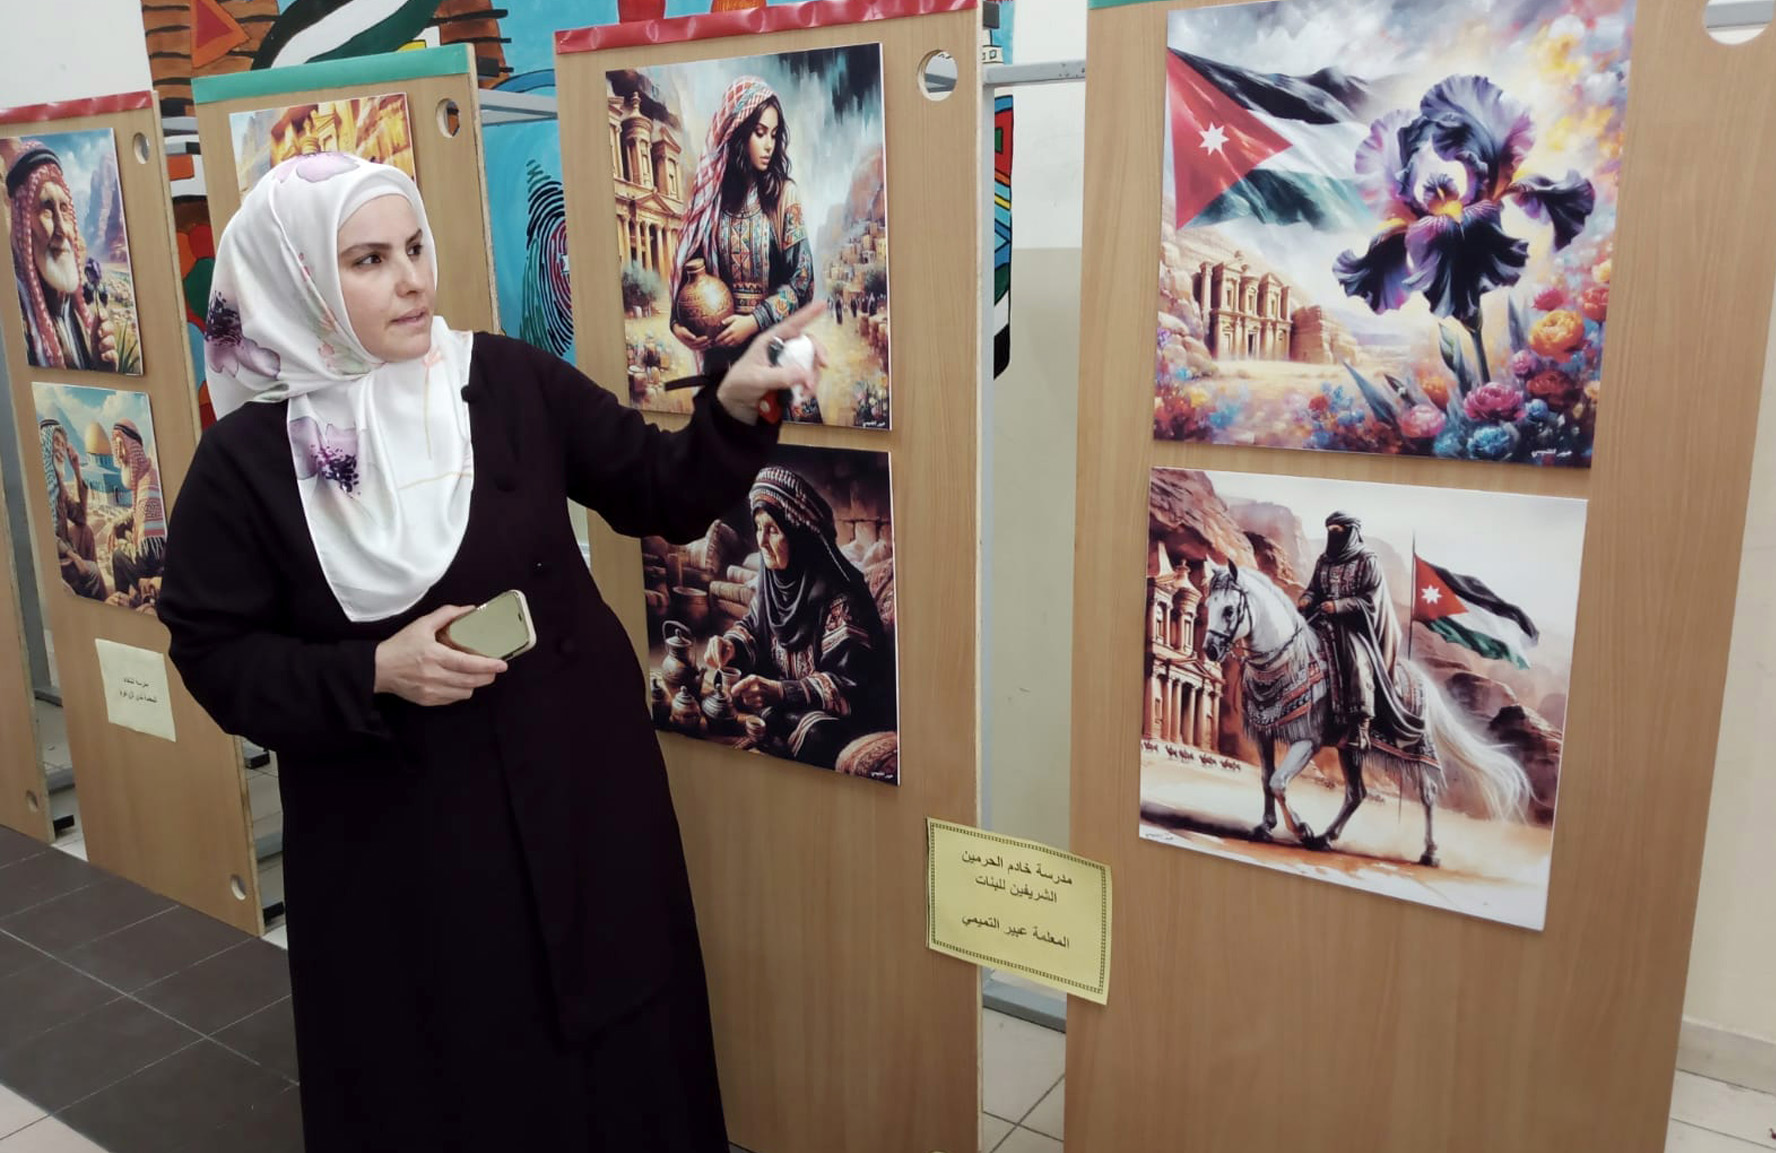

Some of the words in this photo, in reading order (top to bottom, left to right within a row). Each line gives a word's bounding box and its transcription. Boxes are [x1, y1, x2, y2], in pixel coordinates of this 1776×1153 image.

[961, 851, 1003, 868] الحرمين
[1007, 861, 1032, 875] خادم
[1035, 862, 1073, 885] مدرسة
[975, 875, 1006, 891] للبنات
[1009, 883, 1058, 903] الشريفين
[961, 916, 1000, 930] التميمي
[1004, 926, 1028, 938] عبير
[1032, 925, 1070, 948] المعلمة
